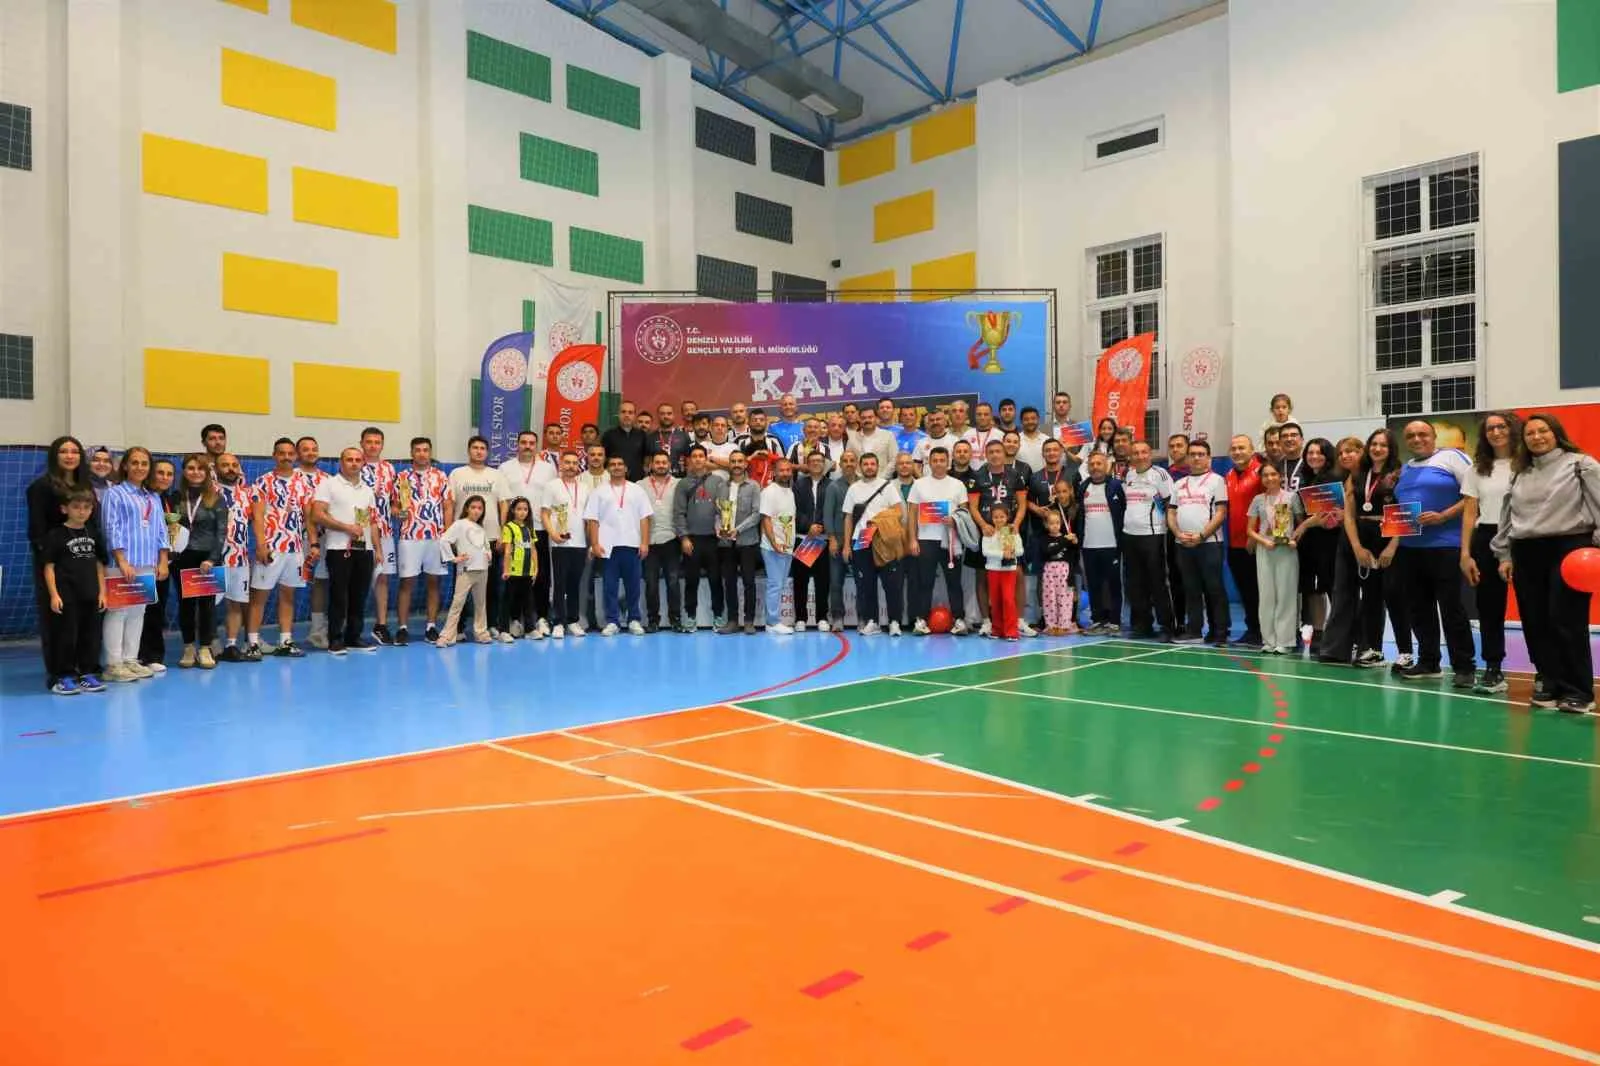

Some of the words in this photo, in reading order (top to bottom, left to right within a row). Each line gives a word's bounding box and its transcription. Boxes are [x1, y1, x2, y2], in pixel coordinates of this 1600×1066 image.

[687, 335, 718, 344] DENİZLİ
[687, 345, 721, 355] GENÇLİK
[723, 346, 733, 354] VE
[735, 346, 757, 354] SPOR
[768, 344, 819, 354] MÜDÜRLÜĞÜ
[750, 360, 904, 402] KAMU
[492, 396, 504, 430] SPOR
[1108, 391, 1121, 420] POR
[1183, 396, 1196, 431] SPOR
[491, 431, 503, 449] VE
